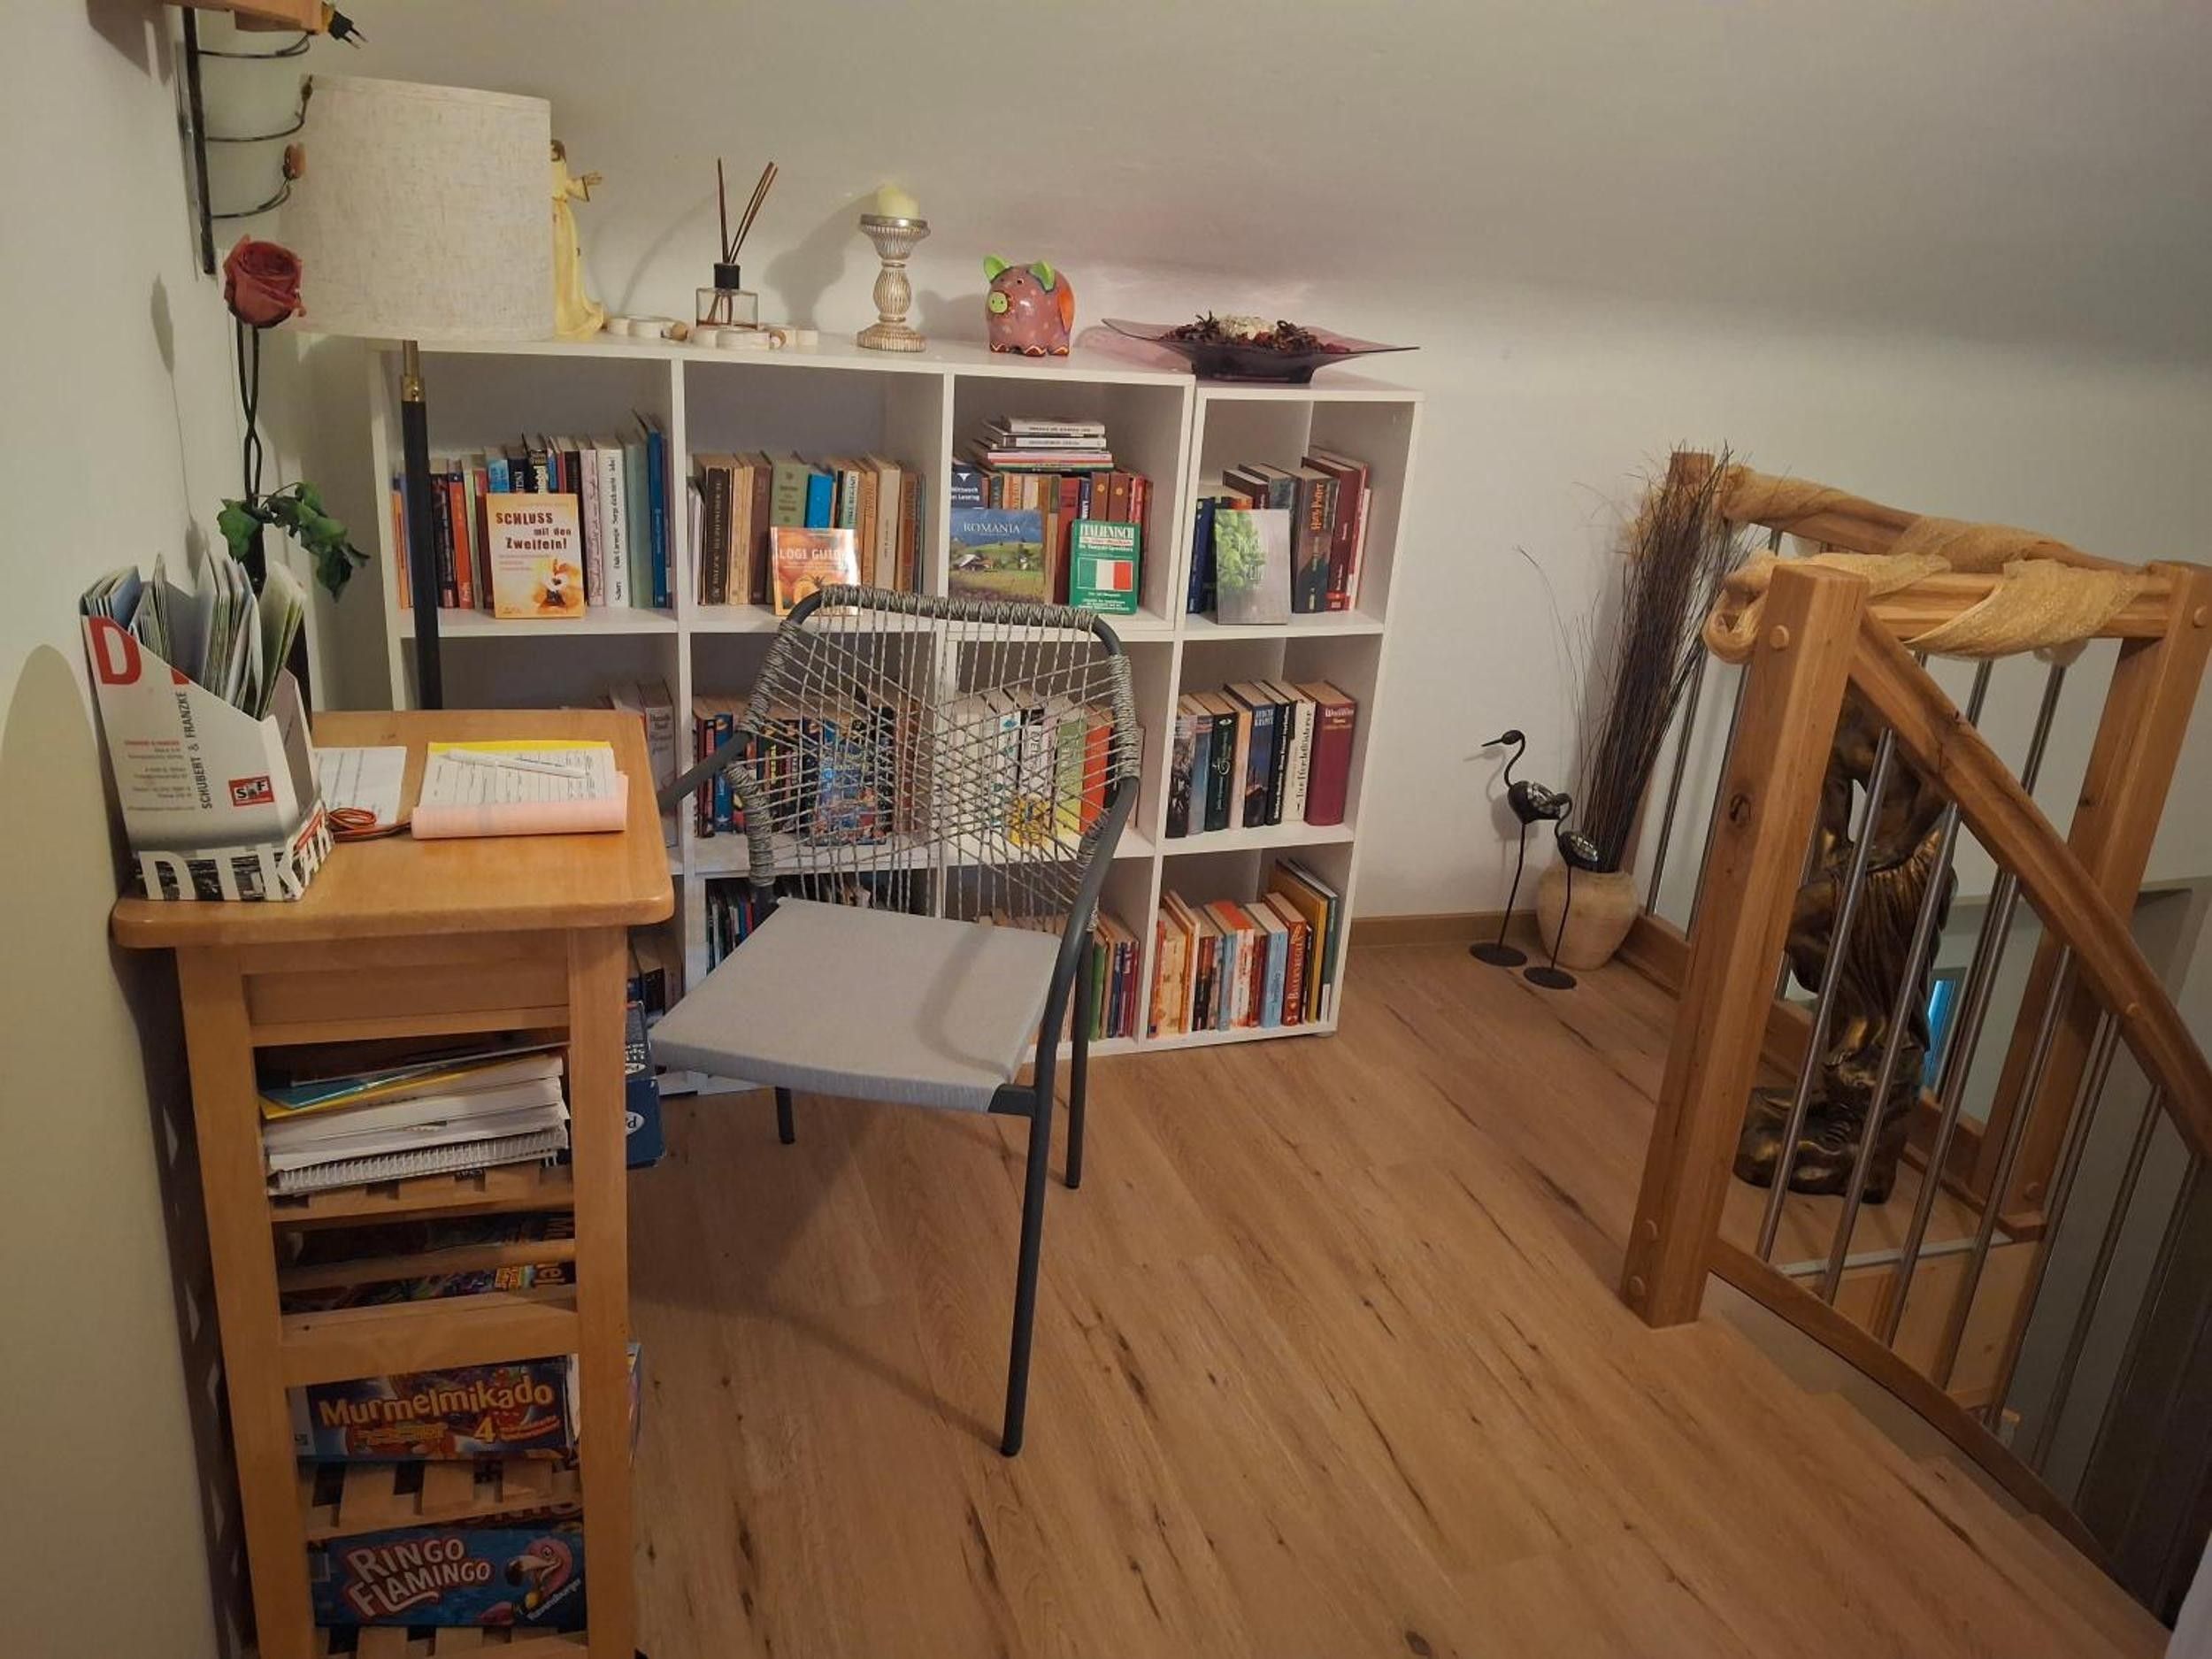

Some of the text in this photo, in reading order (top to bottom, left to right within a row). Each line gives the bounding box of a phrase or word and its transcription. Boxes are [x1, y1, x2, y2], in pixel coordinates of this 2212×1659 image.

[495, 512, 553, 525] SCHLUSS
[534, 527, 572, 536] mit den
[964, 522, 1020, 534] ROMANIA
[505, 536, 567, 549] Zweifeln!
[176, 692, 196, 739] FRANZKE
[191, 757, 213, 810] SCHUBERT
[319, 1374, 555, 1428] Murmelmikado
[474, 1415, 496, 1444] 4
[347, 1538, 465, 1584] RINGO
[348, 1561, 491, 1617] FLAMINGO
